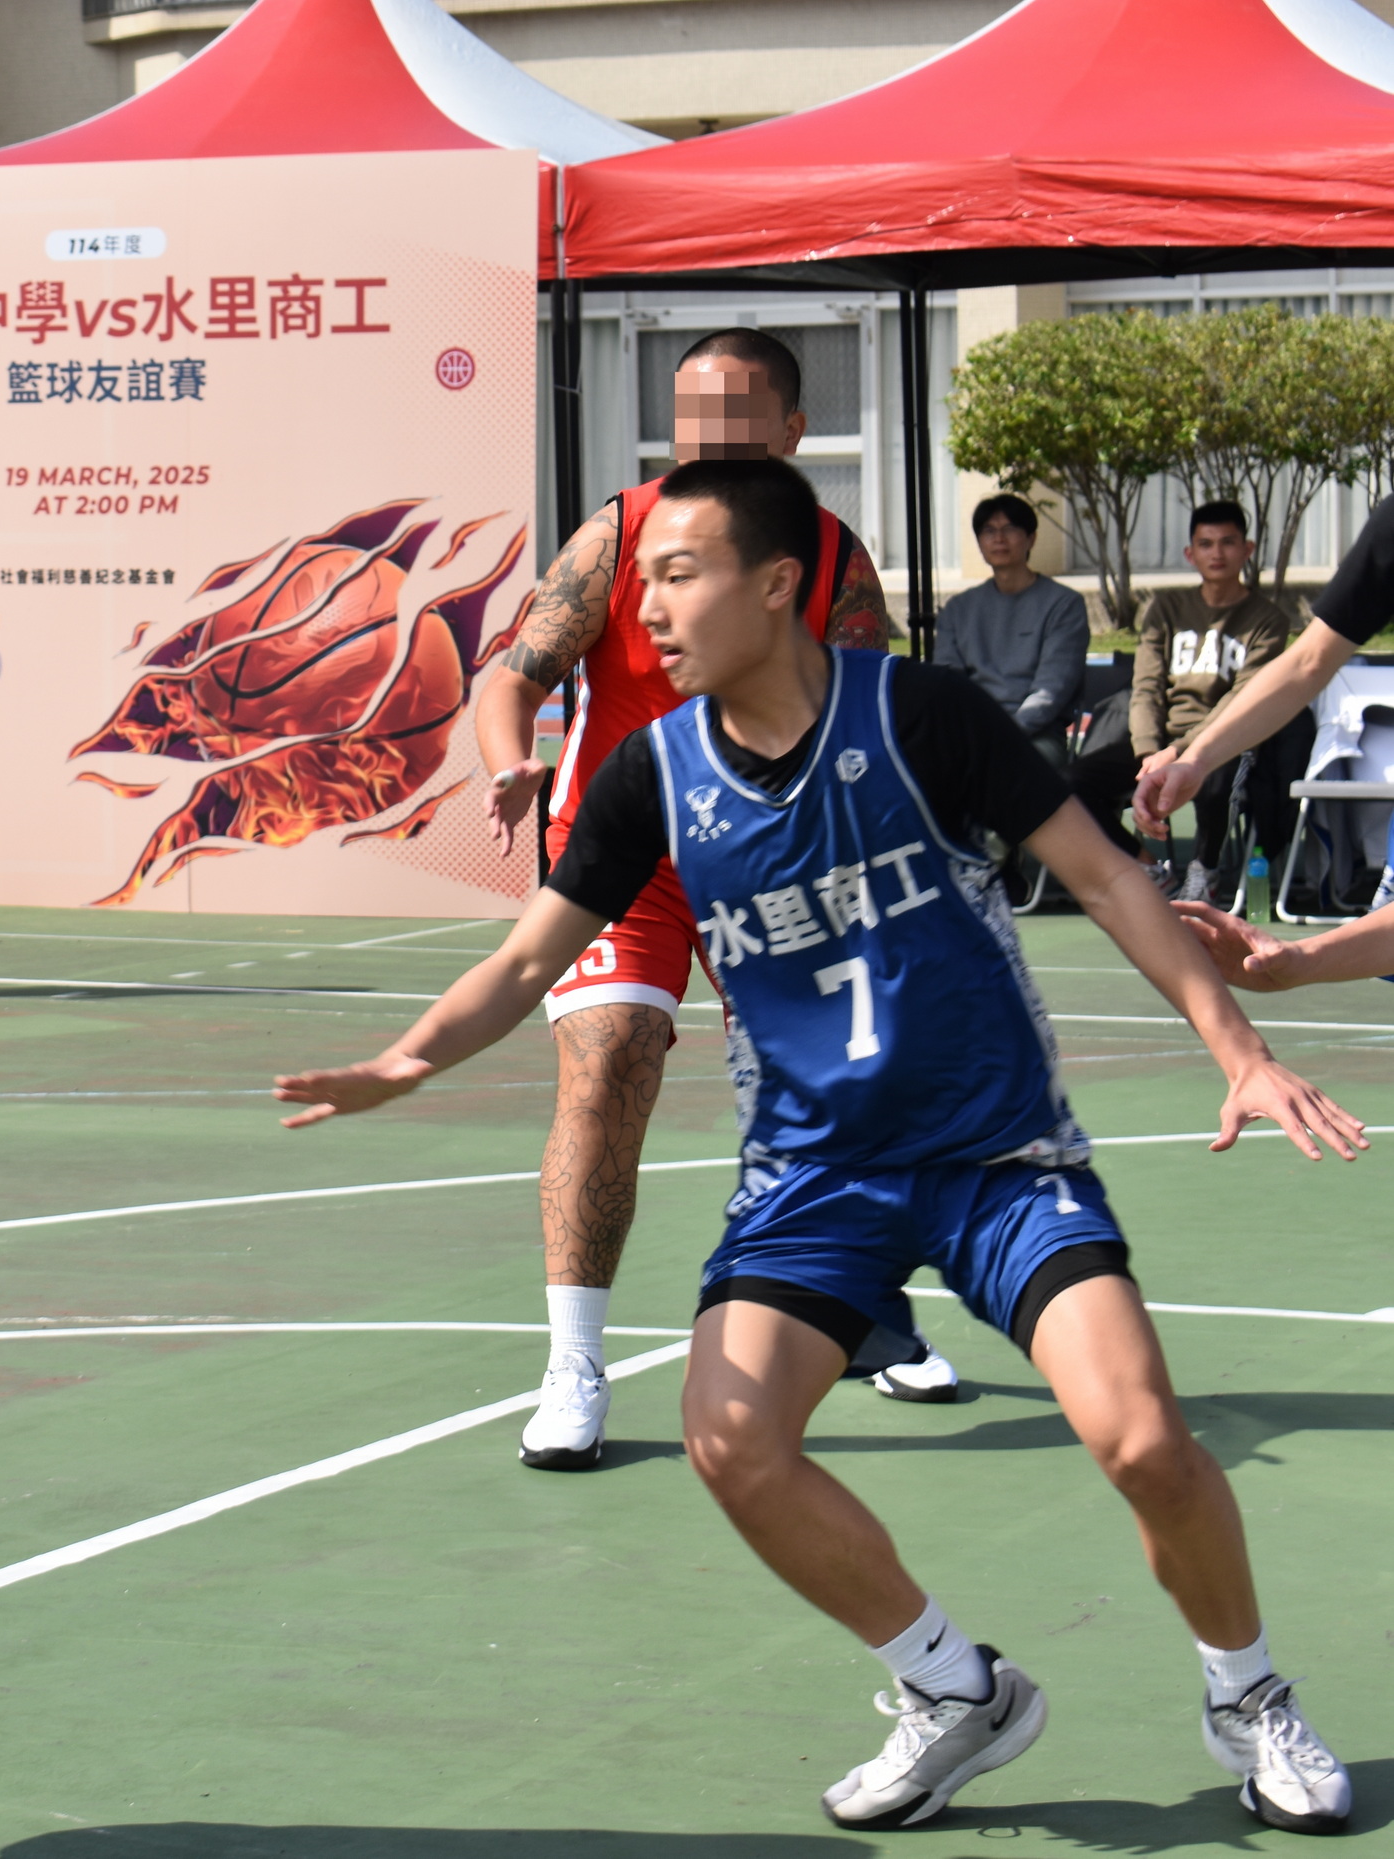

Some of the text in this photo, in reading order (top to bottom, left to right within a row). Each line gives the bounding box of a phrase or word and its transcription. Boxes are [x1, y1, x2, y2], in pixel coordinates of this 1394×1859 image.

[68, 234, 142, 255] 114年度
[6, 357, 208, 404] 籃球友誼賽
[6, 465, 211, 490] 19 MARCH, 2025
[33, 494, 180, 516] AT 2:00 PM
[1170, 629, 1246, 683] GAP
[696, 839, 942, 969] 水里商工
[813, 955, 881, 1062] 7
[1034, 1172, 1083, 1215] 7
